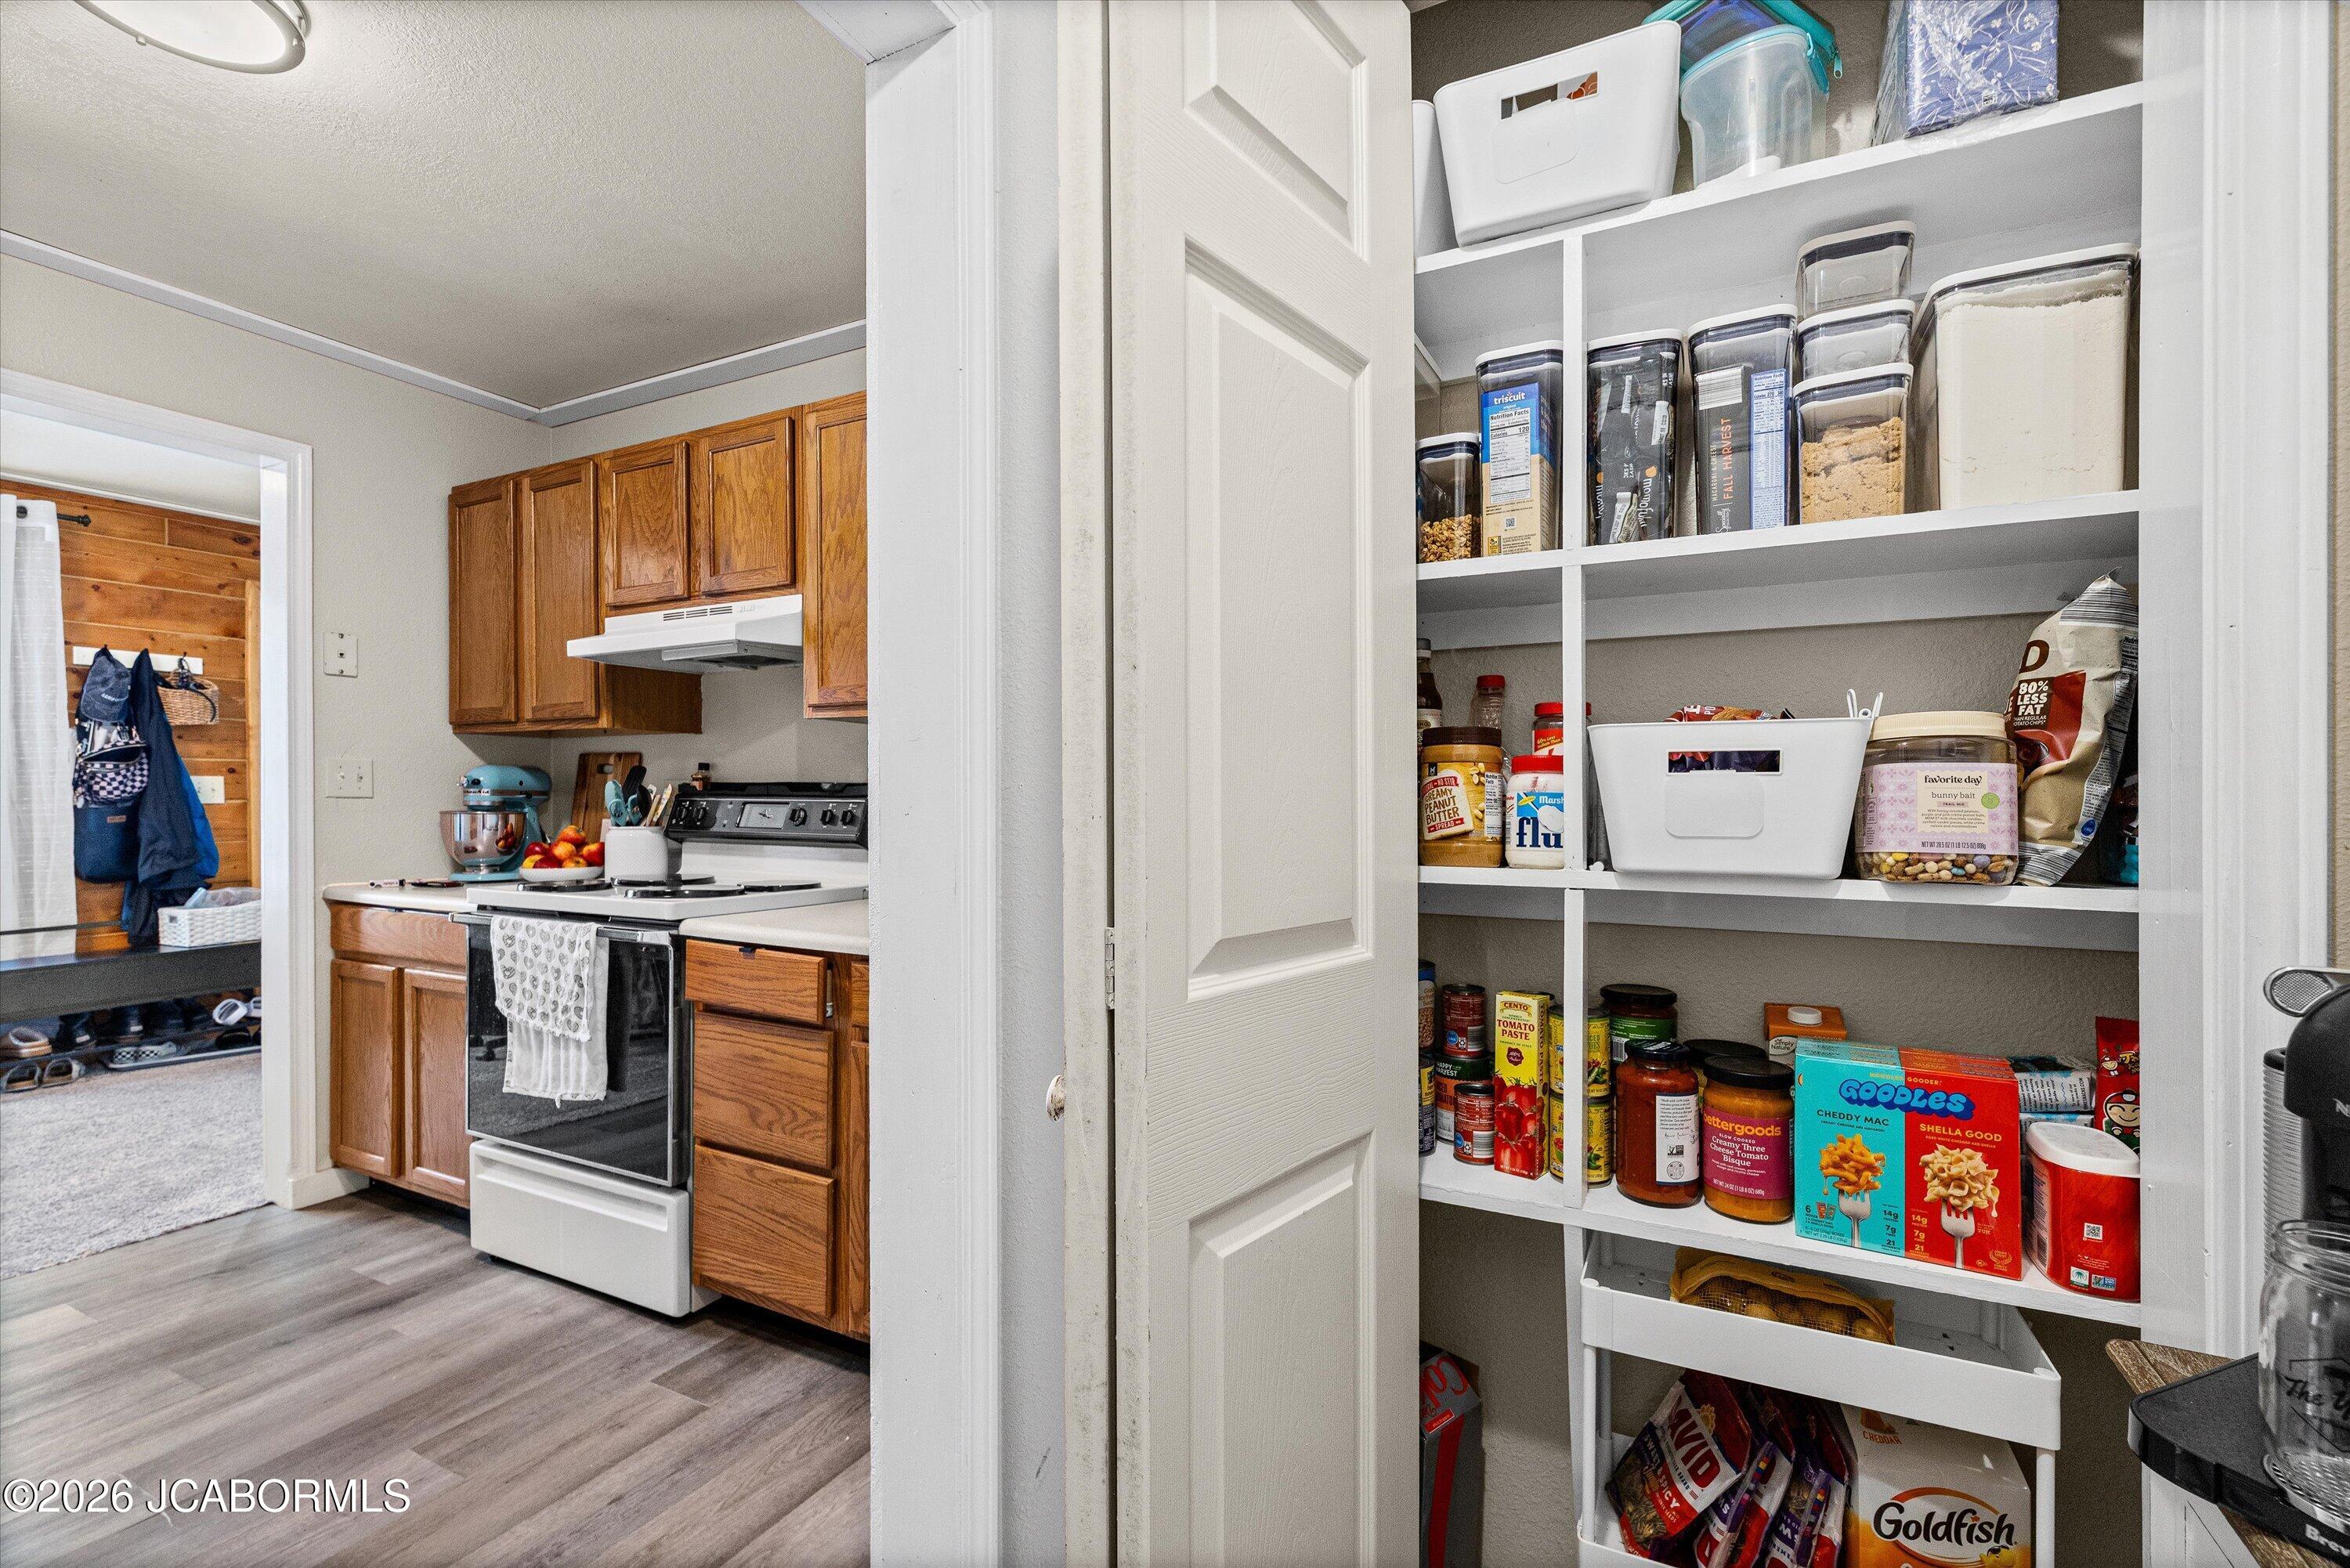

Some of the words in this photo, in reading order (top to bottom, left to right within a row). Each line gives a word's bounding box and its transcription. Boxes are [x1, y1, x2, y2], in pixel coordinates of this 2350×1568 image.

[1494, 392, 1526, 404] triscuit
[1721, 418, 1733, 470] HARVEST
[1723, 474, 1734, 500] FALL
[2019, 681, 2048, 695] 80%
[2017, 693, 2048, 705] LESS
[2018, 704, 2044, 716] FAT
[1925, 775, 1963, 783] favorite
[1964, 775, 1983, 786] day
[1425, 788, 1453, 802] CREAMY
[1425, 795, 1456, 814] PEANUT
[1426, 806, 1460, 825] BUTTER
[1435, 821, 1455, 830] SPREAD
[1504, 1002, 1528, 1011] CENTO
[1497, 1019, 1535, 1031] TOMATO
[1502, 1028, 1530, 1040] PASTE
[1774, 1038, 1794, 1046] Simply
[1817, 1109, 1862, 1122] CHEDDY
[1864, 1116, 1889, 1126] MAC
[1919, 1123, 1962, 1136] SHELLA
[1965, 1129, 2002, 1142] GOOD
[1712, 1136, 1741, 1150] Creamy
[1741, 1143, 1766, 1153] Three
[1710, 1142, 1734, 1156] Cheese
[1735, 1150, 1769, 1161] Tomato
[1723, 1154, 1752, 1167] Bisque
[1882, 1209, 1899, 1219] 14g
[1911, 1214, 1928, 1225] 14g
[1885, 1224, 1896, 1234] 7g
[1914, 1230, 1925, 1239] 7g
[1863, 1430, 1903, 1445] CHEDDAR
[1643, 1434, 1661, 1467] SWEET
[1659, 1475, 1682, 1510] SPICY
[1873, 1501, 2015, 1547] Goldfish
